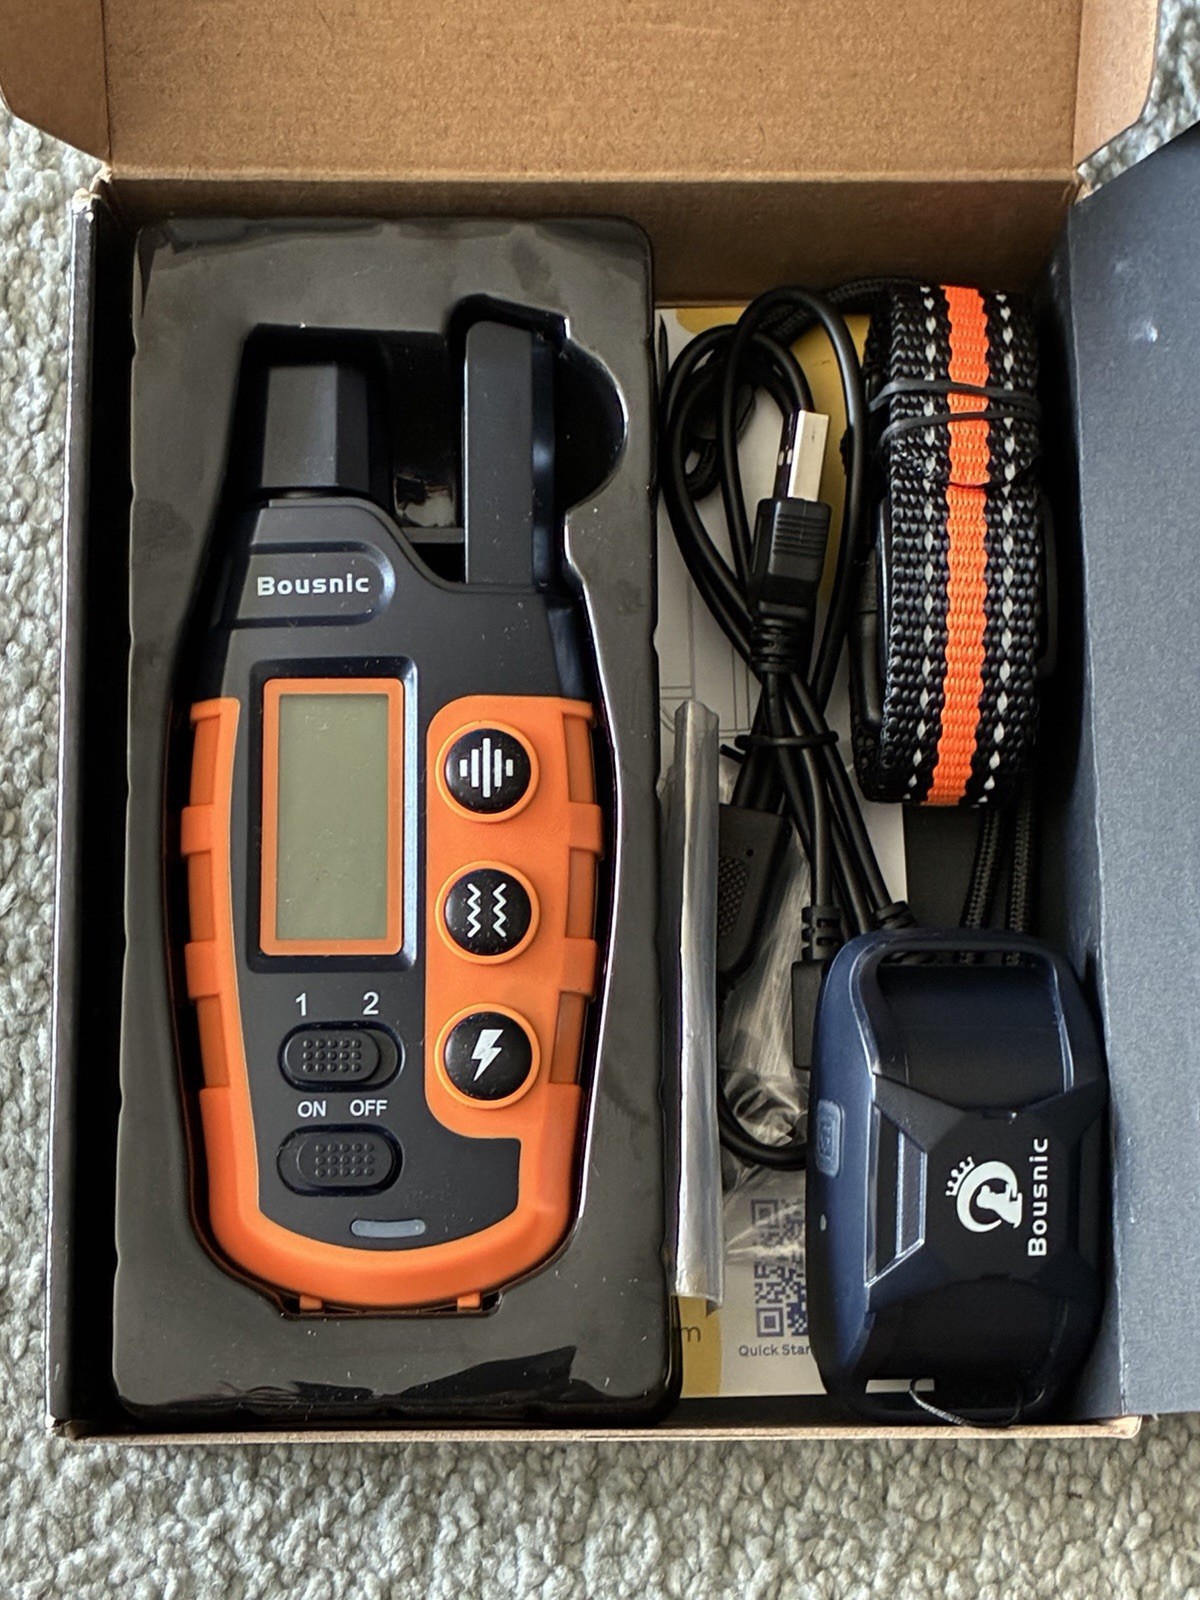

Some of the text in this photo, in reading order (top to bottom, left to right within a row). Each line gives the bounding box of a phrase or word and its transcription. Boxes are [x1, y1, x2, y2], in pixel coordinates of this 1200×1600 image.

[257, 573, 369, 596] Bousnic
[295, 991, 379, 1017] 1 2
[297, 1099, 388, 1118] ON OFF
[1027, 1138, 1048, 1257] Bousnic
[738, 1344, 779, 1357] Quick
